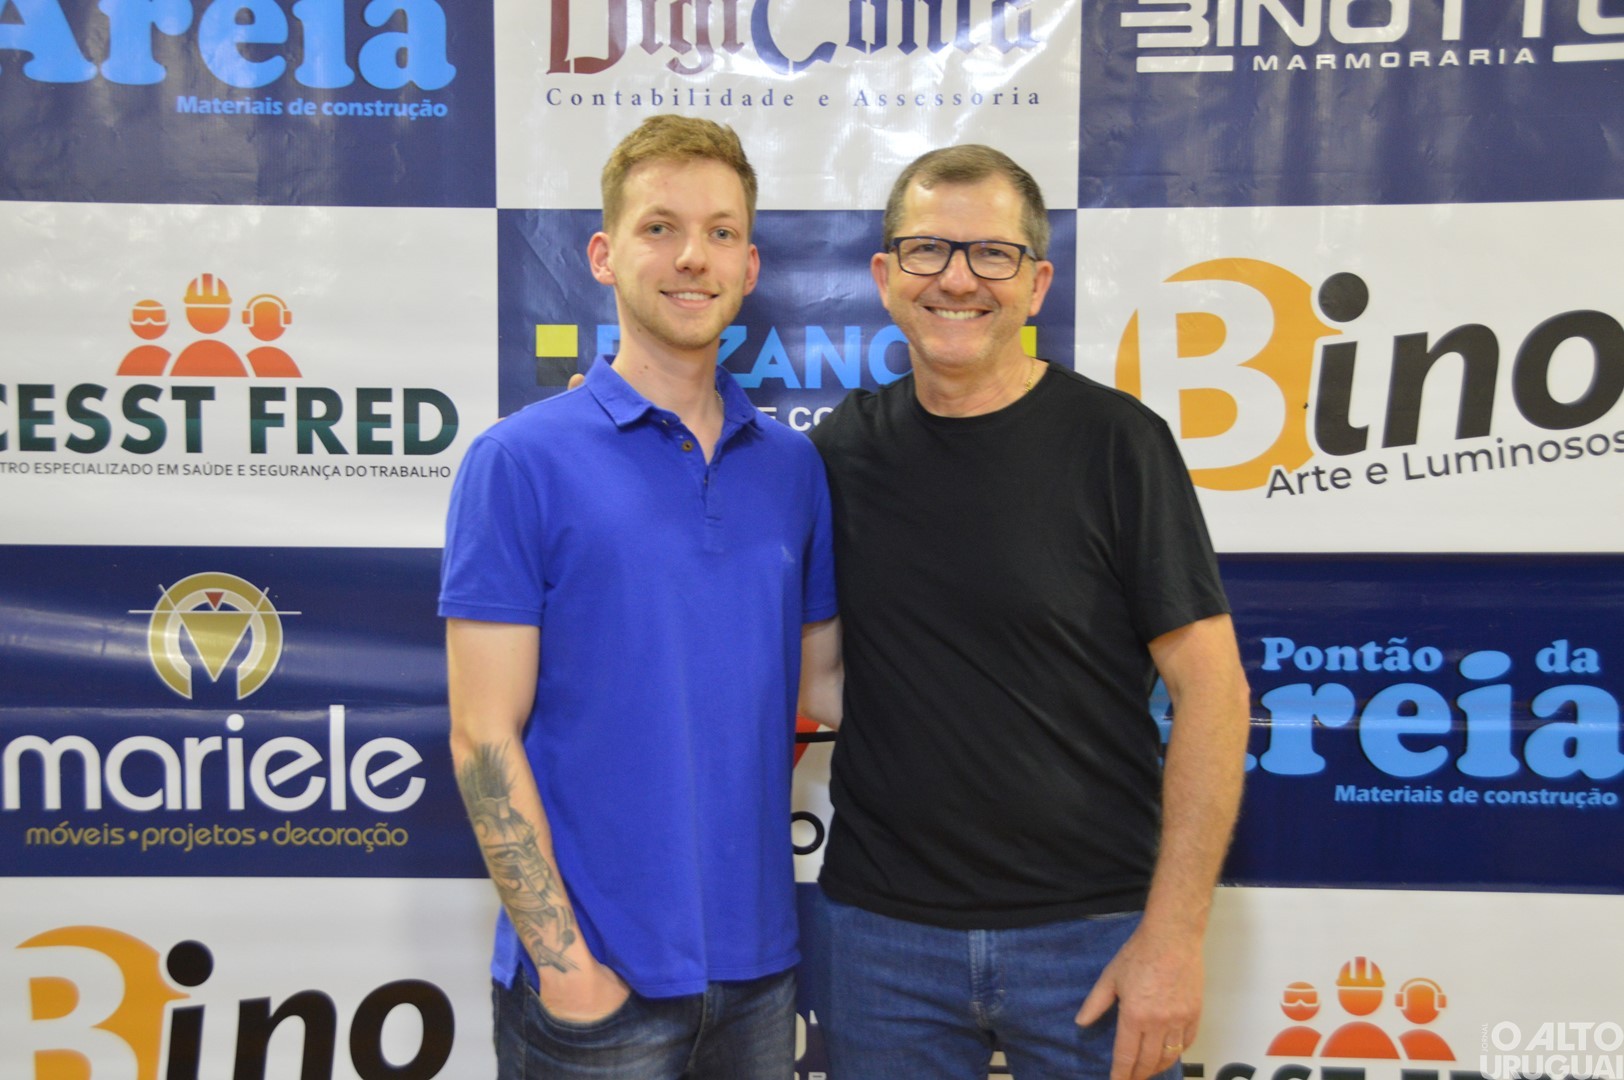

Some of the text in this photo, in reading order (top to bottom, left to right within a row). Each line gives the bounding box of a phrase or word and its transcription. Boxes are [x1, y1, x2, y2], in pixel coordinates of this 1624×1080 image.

[1252, 48, 1536, 71] MARMORARIA
[176, 95, 448, 120] Materiais de construção
[546, 87, 1040, 107] Contabilidade e Assessoria
[1136, 262, 1624, 472] Bino
[0, 383, 459, 455] ESST FRED
[34, 462, 152, 475] ESPECIALIZADO
[157, 463, 179, 475] EM
[183, 461, 233, 476] SAÚDE
[238, 464, 246, 476] E
[250, 464, 340, 480] SEGURANÇA
[345, 465, 367, 477] DO
[370, 466, 451, 478] TRABALHO
[1266, 430, 1624, 498] Arte e Luminosos
[1260, 636, 1600, 674] Pontão da
[1150, 650, 1624, 779] reia
[2, 704, 426, 812] mariele
[1334, 784, 1618, 810] Materiais de construção
